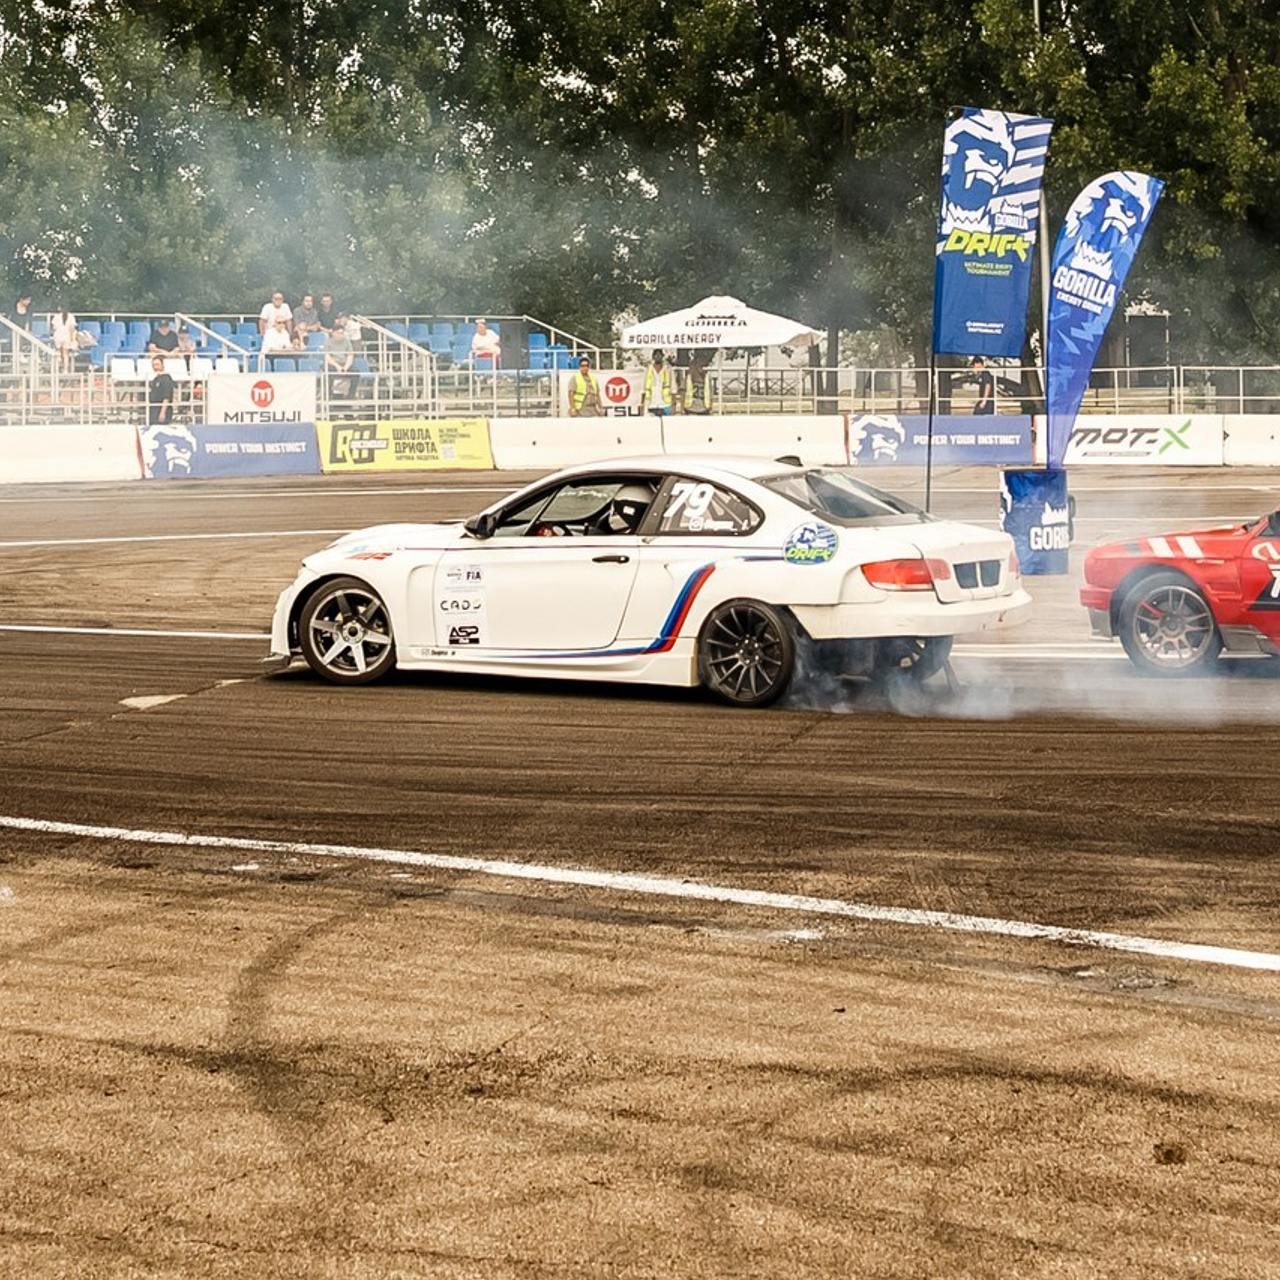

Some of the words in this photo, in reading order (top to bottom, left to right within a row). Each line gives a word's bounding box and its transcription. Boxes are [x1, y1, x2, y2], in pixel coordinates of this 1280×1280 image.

[945, 227, 1030, 262] DRIFT
[1053, 266, 1116, 308] GORILLA
[628, 333, 722, 345] #GORILLAENERGY
[224, 411, 301, 423] MITSUJI
[392, 428, 431, 440] ШКОЛА
[949, 435, 976, 445] YOUR
[977, 435, 1021, 445] INSTINCT
[205, 443, 238, 454] POWER
[239, 443, 264, 453] YOUR
[265, 442, 307, 453] INSTINCT
[395, 441, 438, 454] ДРИФТА
[663, 482, 716, 519] 79
[787, 547, 832, 559] DRIFT
[466, 571, 481, 580] FIA
[449, 625, 479, 637] ASP
